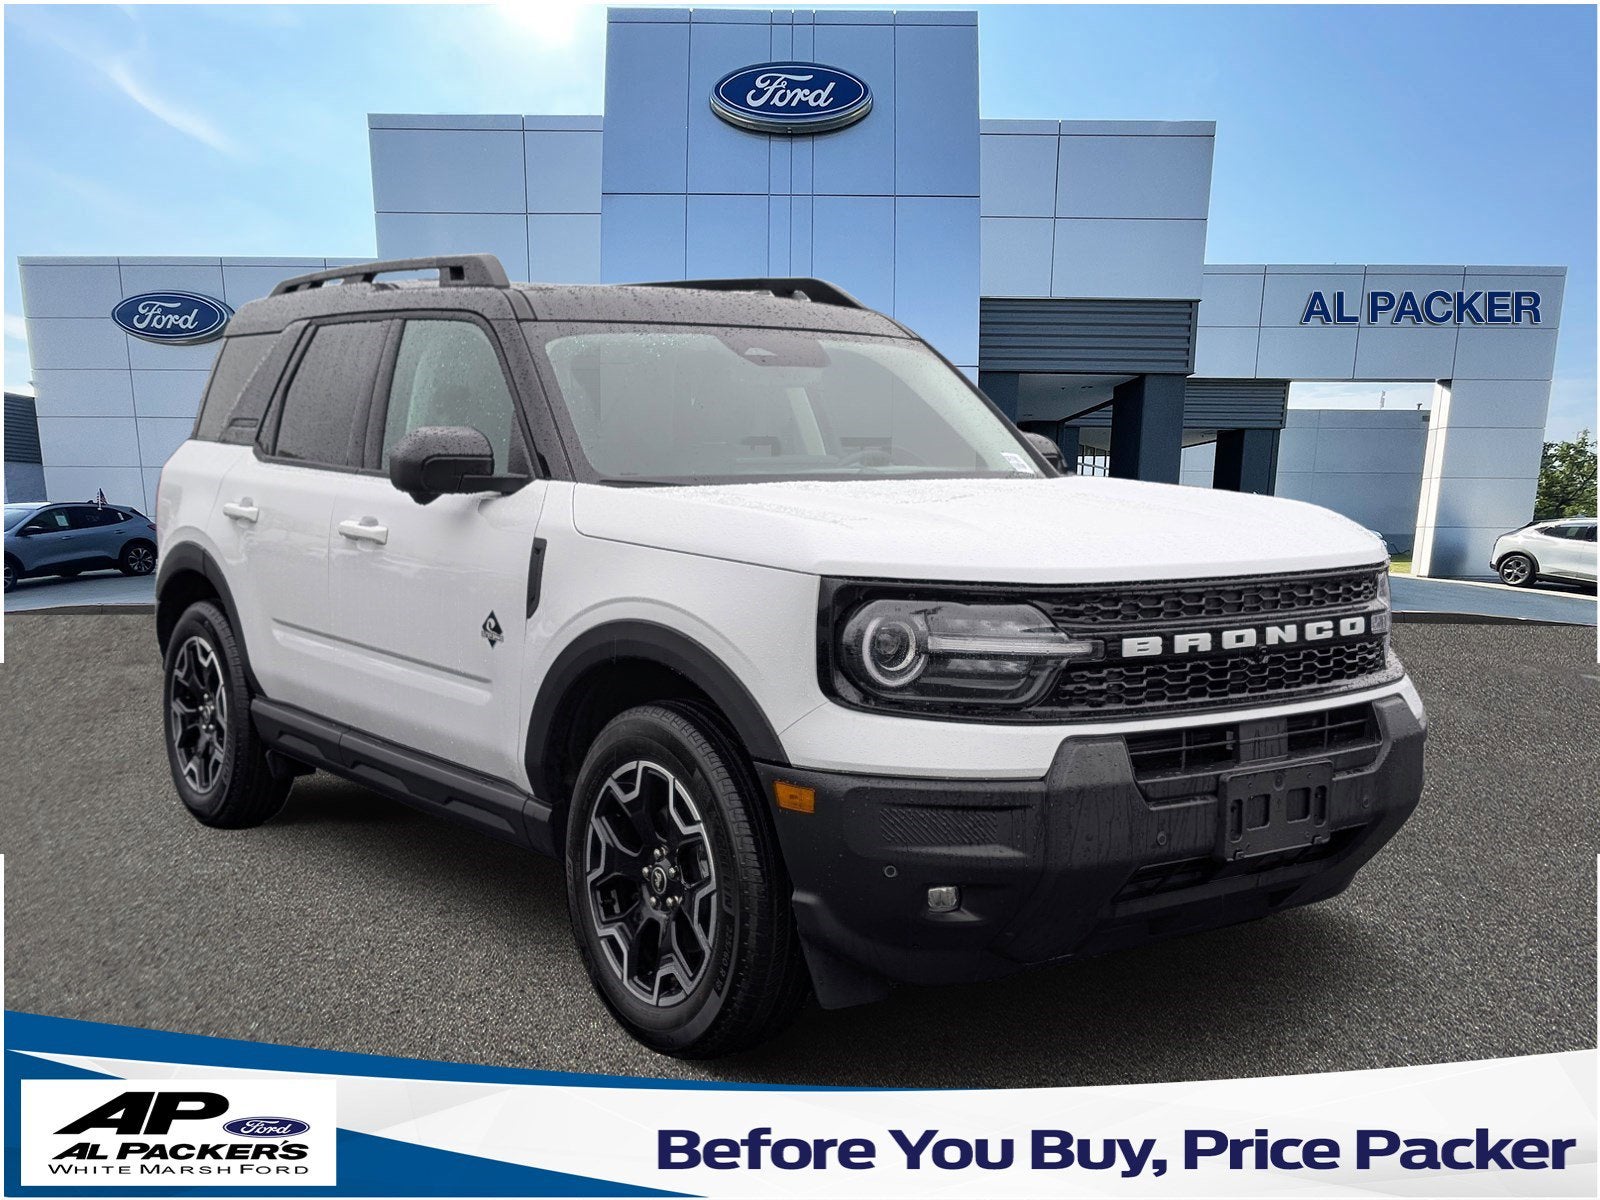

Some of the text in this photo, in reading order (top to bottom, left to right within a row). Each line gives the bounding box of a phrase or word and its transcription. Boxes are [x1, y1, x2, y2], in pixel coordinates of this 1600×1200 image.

[746, 73, 836, 107] Ford
[133, 301, 199, 329] Ford
[1301, 289, 1543, 324] AL PACKER
[1121, 616, 1366, 658] BRONCO
